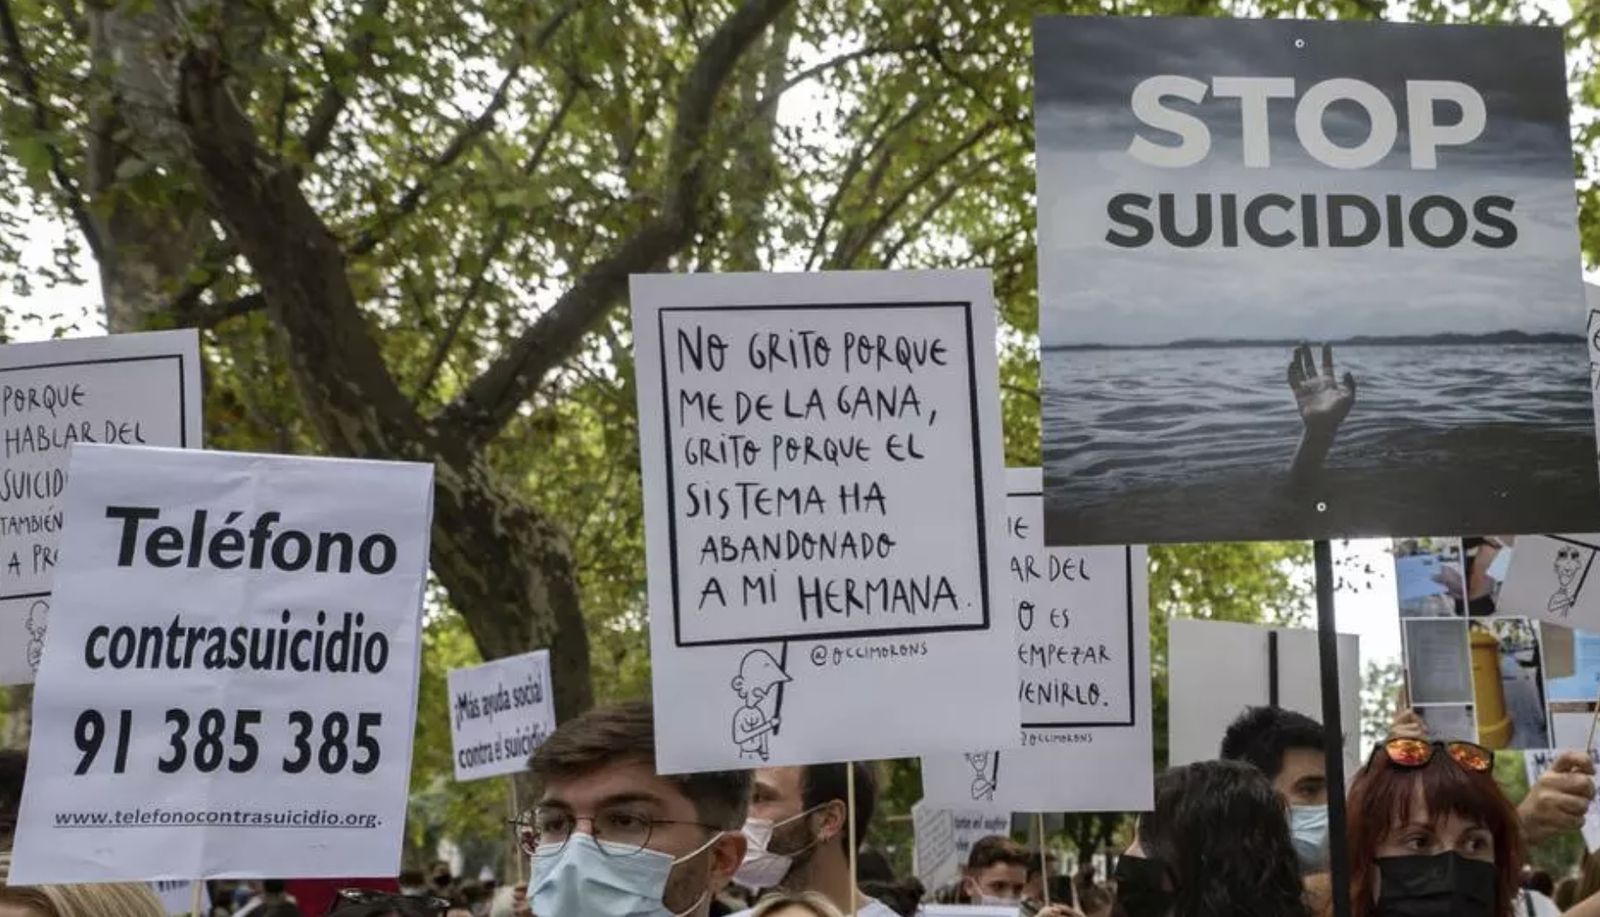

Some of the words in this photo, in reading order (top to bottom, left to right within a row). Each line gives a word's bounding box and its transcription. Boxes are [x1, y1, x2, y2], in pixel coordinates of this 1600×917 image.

[1126, 74, 1488, 170] STOP
[1104, 192, 1519, 249] SUICIDIOS
[677, 324, 729, 373] NO
[748, 329, 832, 373] GRITO
[844, 330, 948, 373] PORQUE
[3, 383, 86, 418] PORQUE
[679, 387, 725, 427] ME
[735, 389, 773, 425] DE
[784, 387, 827, 421] LA
[836, 384, 938, 426] GANA,
[5, 421, 97, 459] HABLAR
[105, 419, 146, 445] DEL
[684, 433, 762, 468] GRITO
[772, 434, 871, 471] PORQUE
[886, 432, 925, 461] EL
[686, 481, 827, 521] SISTEMA
[838, 481, 887, 517] HA
[105, 504, 398, 576] Teléfono
[699, 528, 897, 565] ABANDONADO
[8, 551, 21, 577] A
[1049, 554, 1091, 582] DEL
[698, 576, 727, 610] A
[797, 574, 972, 622] HERMANA.
[1050, 608, 1070, 629] ES
[84, 608, 390, 674] contrasuicidio
[1017, 642, 1112, 669] EMPEZAR
[482, 681, 512, 725] ayuda
[512, 673, 544, 709] social
[73, 708, 133, 776] 91
[157, 707, 264, 775] 385
[281, 710, 383, 776] 385
[457, 739, 495, 770] contra
[494, 731, 503, 761] el
[53, 807, 383, 829] www.telefonocontrasuicidio.org.
